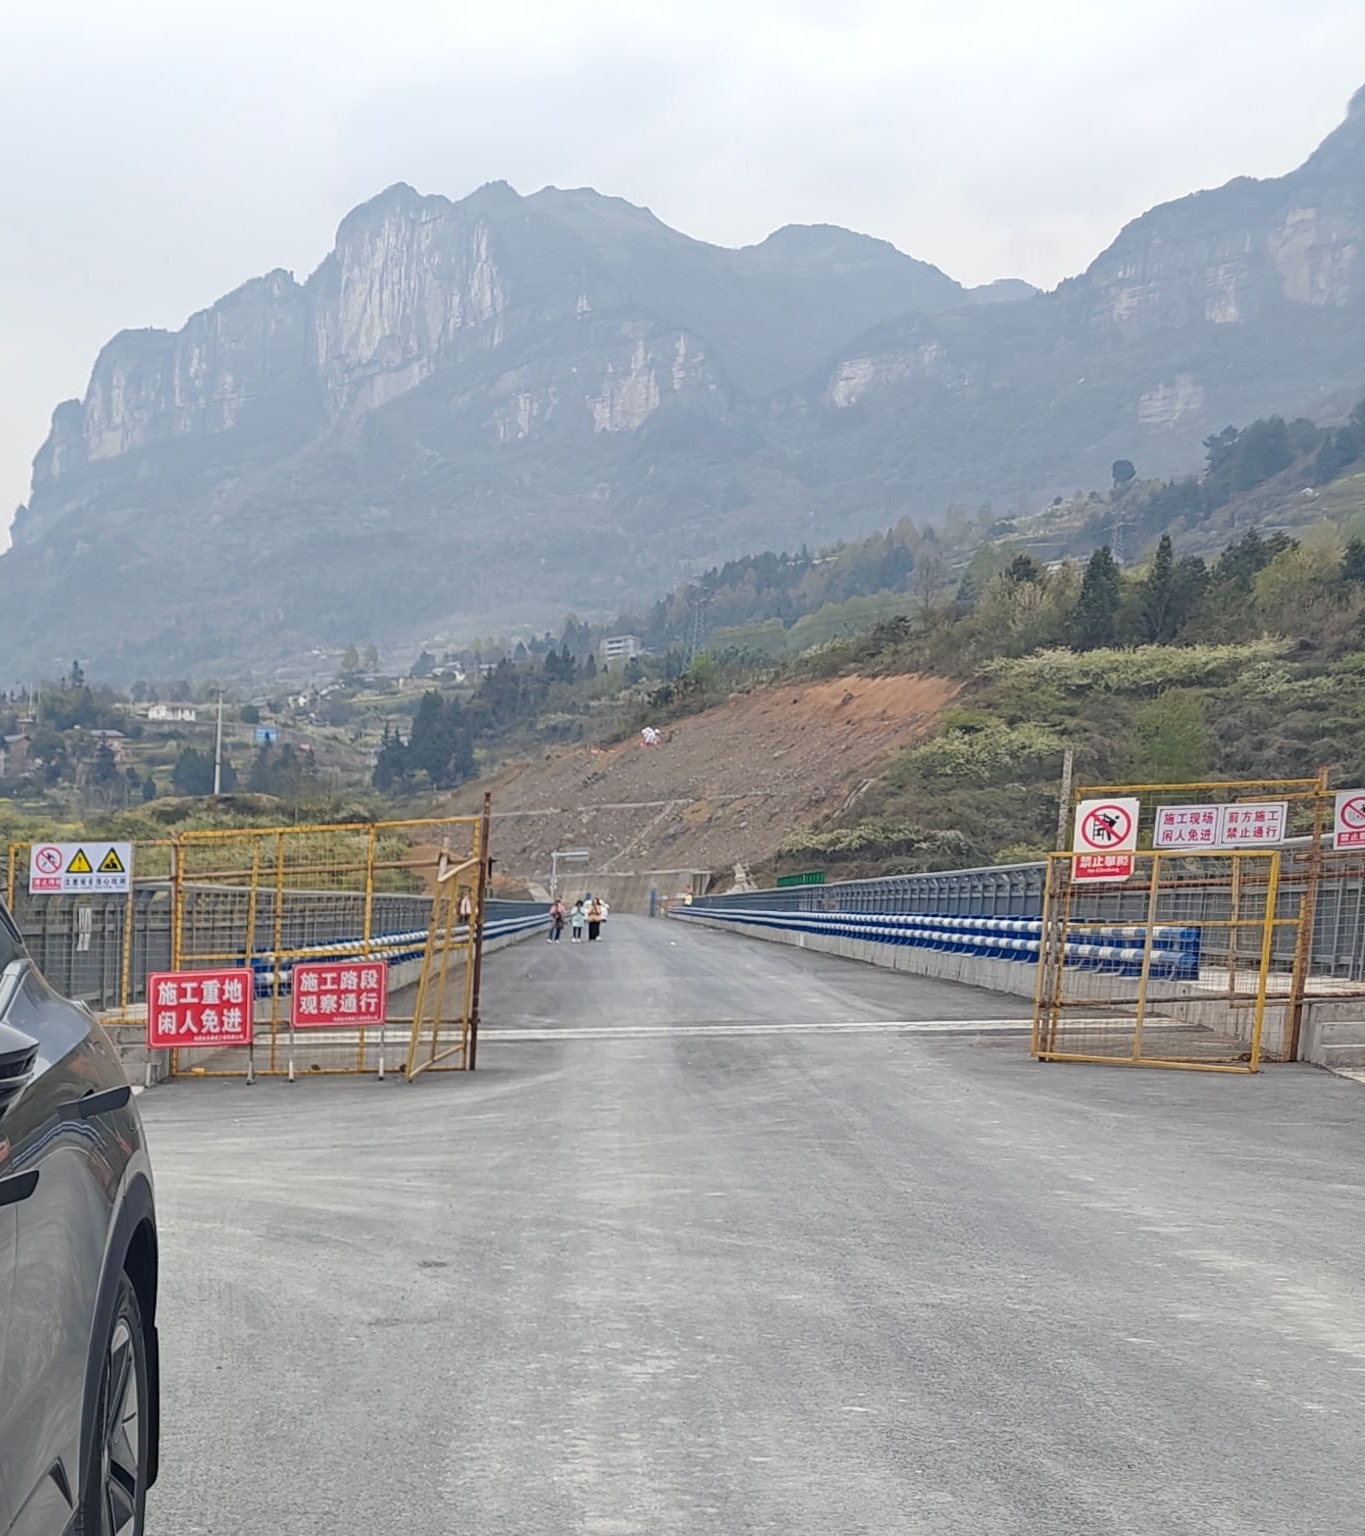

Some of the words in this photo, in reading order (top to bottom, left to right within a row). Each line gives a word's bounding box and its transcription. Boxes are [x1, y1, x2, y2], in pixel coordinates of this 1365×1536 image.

[1163, 811, 1214, 825] 施工现场
[1228, 810, 1279, 823] 前方施工
[1161, 828, 1212, 842] 闲人免进
[1226, 825, 1278, 839] 禁止通行
[299, 969, 379, 992] 施工路段
[157, 978, 244, 1006] 施工重地
[299, 992, 379, 1015] 观察通行
[157, 1007, 243, 1036] 闲人免进
